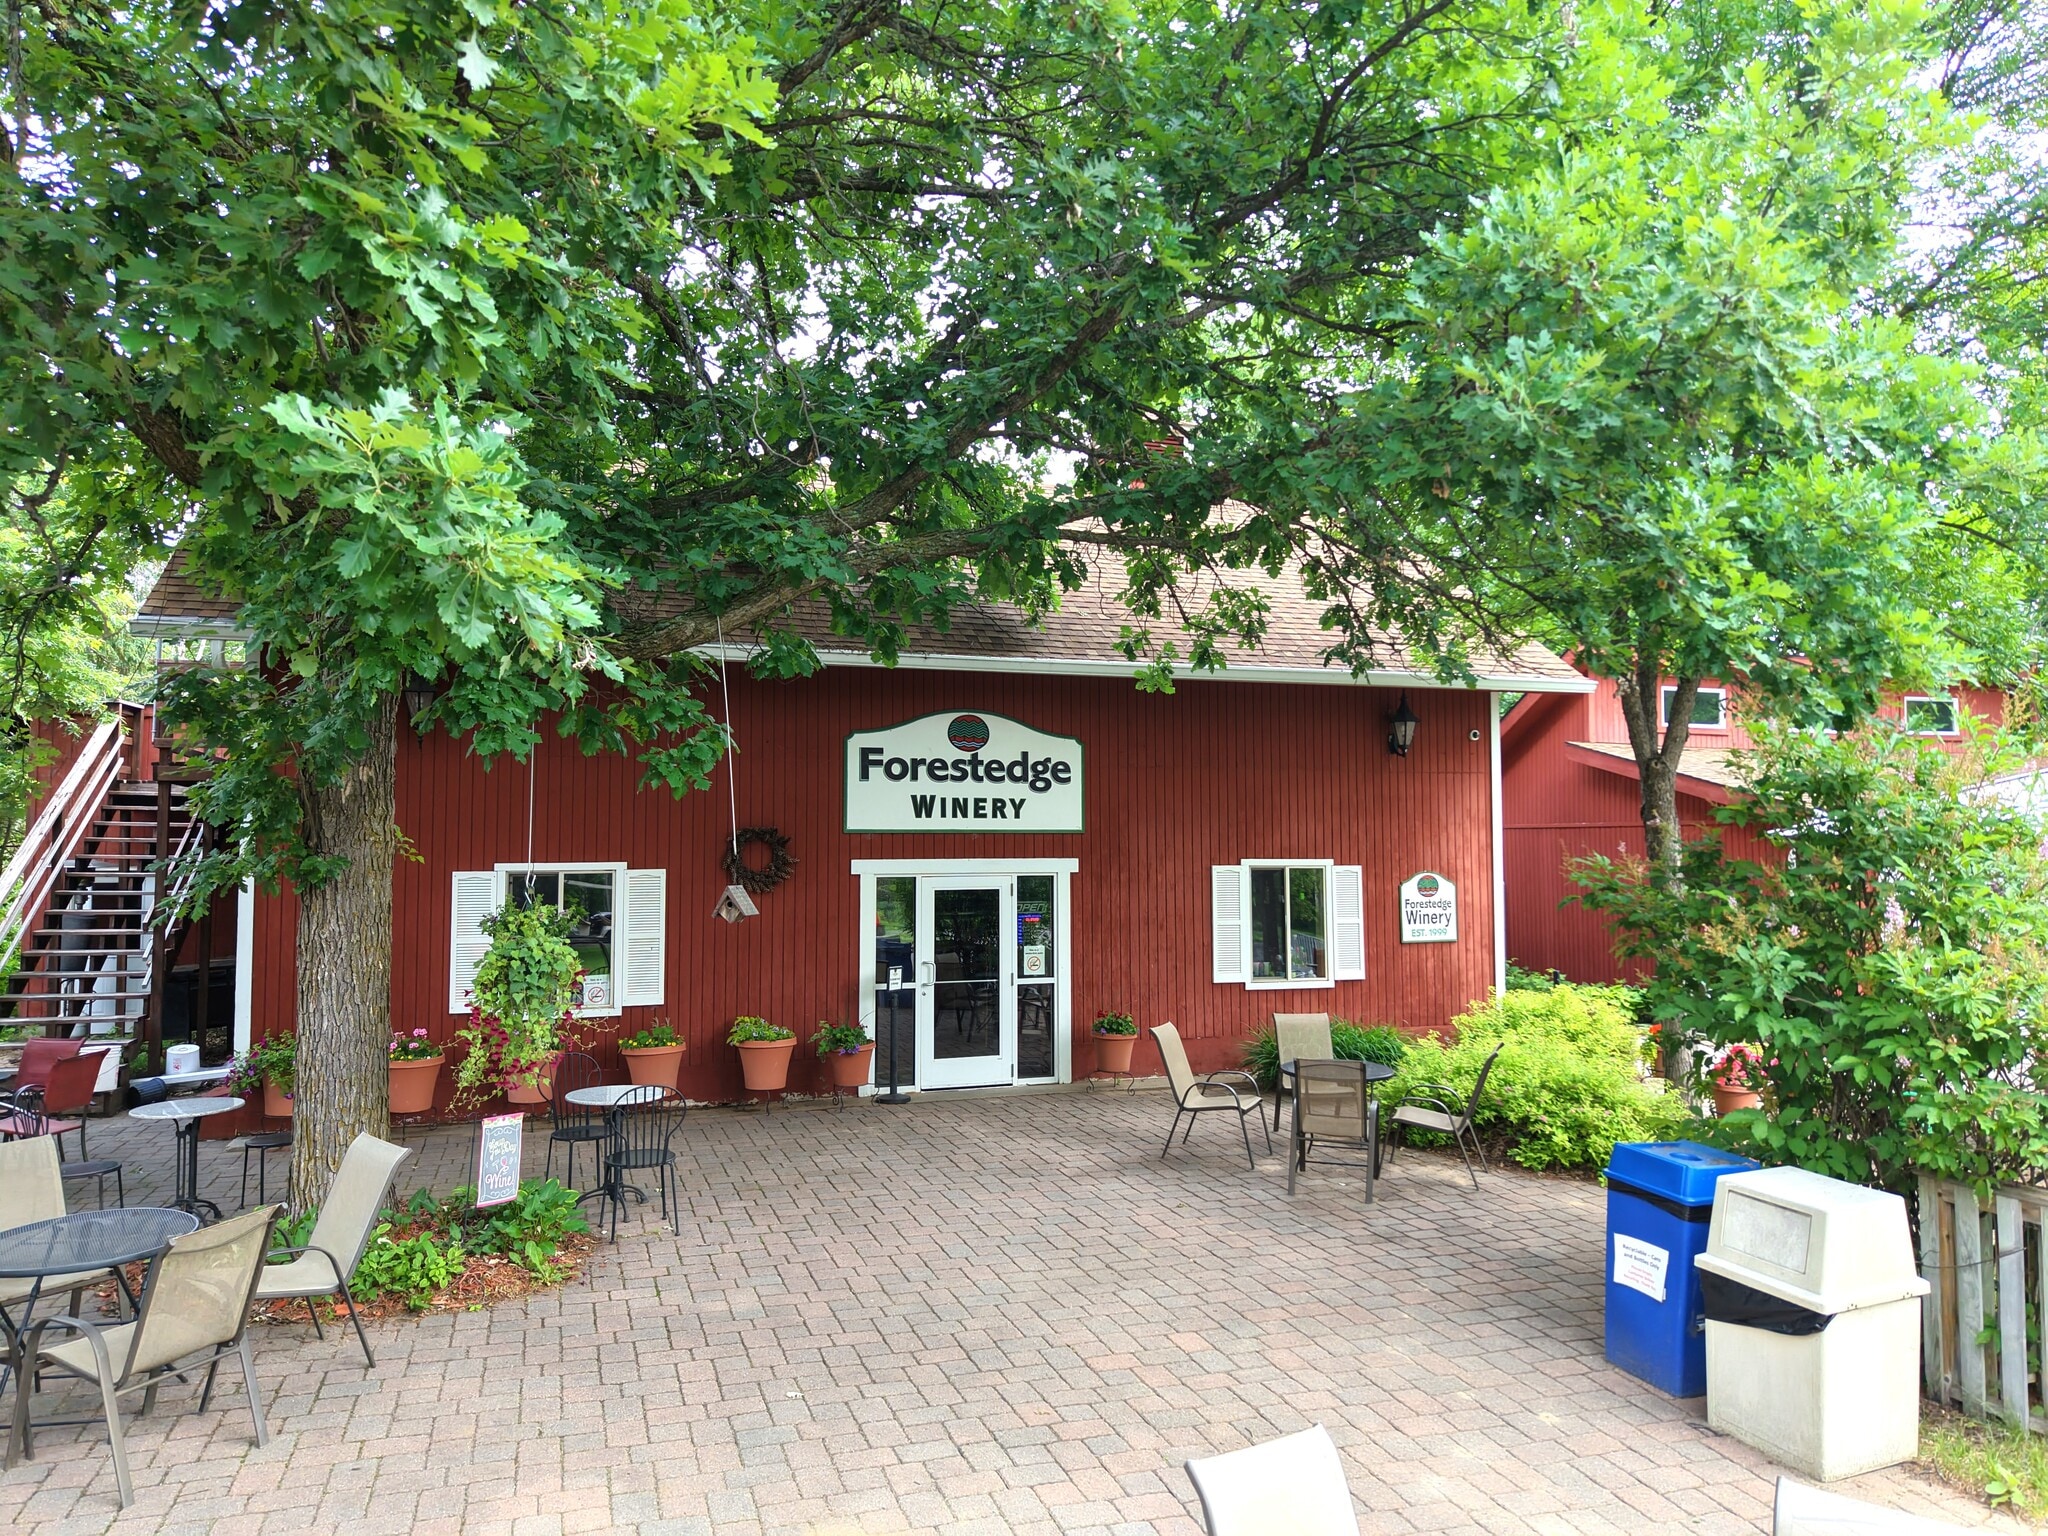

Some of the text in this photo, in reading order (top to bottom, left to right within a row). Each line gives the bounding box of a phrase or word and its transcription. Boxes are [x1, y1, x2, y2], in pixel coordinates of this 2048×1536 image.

[859, 747, 1072, 793] Forestedge
[910, 794, 1026, 819] WINERY
[1017, 903, 1048, 912] OPEN
[1405, 898, 1452, 911] Forestedge
[1405, 910, 1452, 927] Winery
[1411, 928, 1448, 937] EST. 1999
